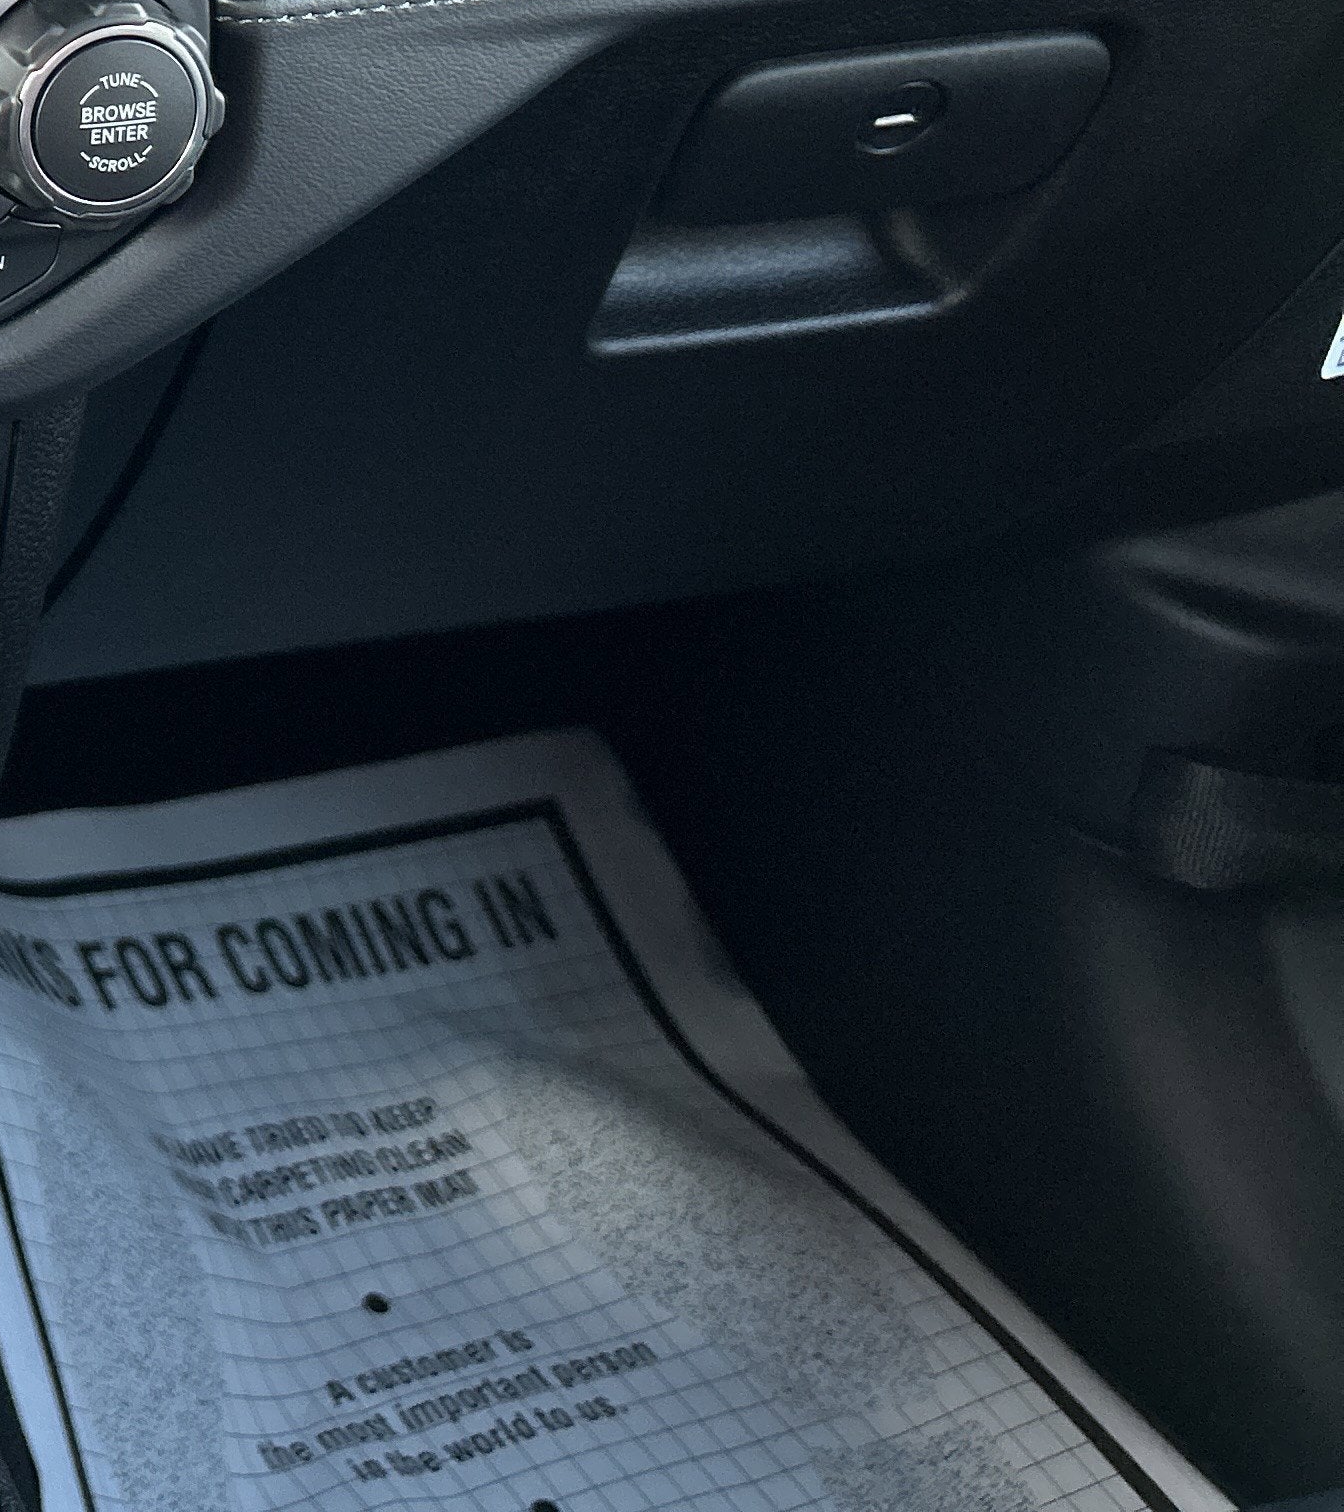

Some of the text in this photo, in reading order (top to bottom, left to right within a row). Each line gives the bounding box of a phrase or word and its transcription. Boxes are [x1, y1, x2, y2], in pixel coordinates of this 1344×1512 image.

[100, 73, 141, 90] TUNE
[81, 100, 157, 123] BROWSE
[91, 124, 149, 145] ENTER
[88, 154, 145, 173] SCROLL
[75, 931, 216, 1013] FOR
[216, 886, 477, 995] COMING
[476, 873, 560, 950] IN
[325, 1329, 535, 1407] A customer is
[316, 1413, 397, 1454] most
[394, 1365, 553, 1434] important
[550, 1341, 659, 1391] person
[347, 1457, 389, 1483] in
[443, 1412, 538, 1462] world
[534, 1406, 575, 1432] to
